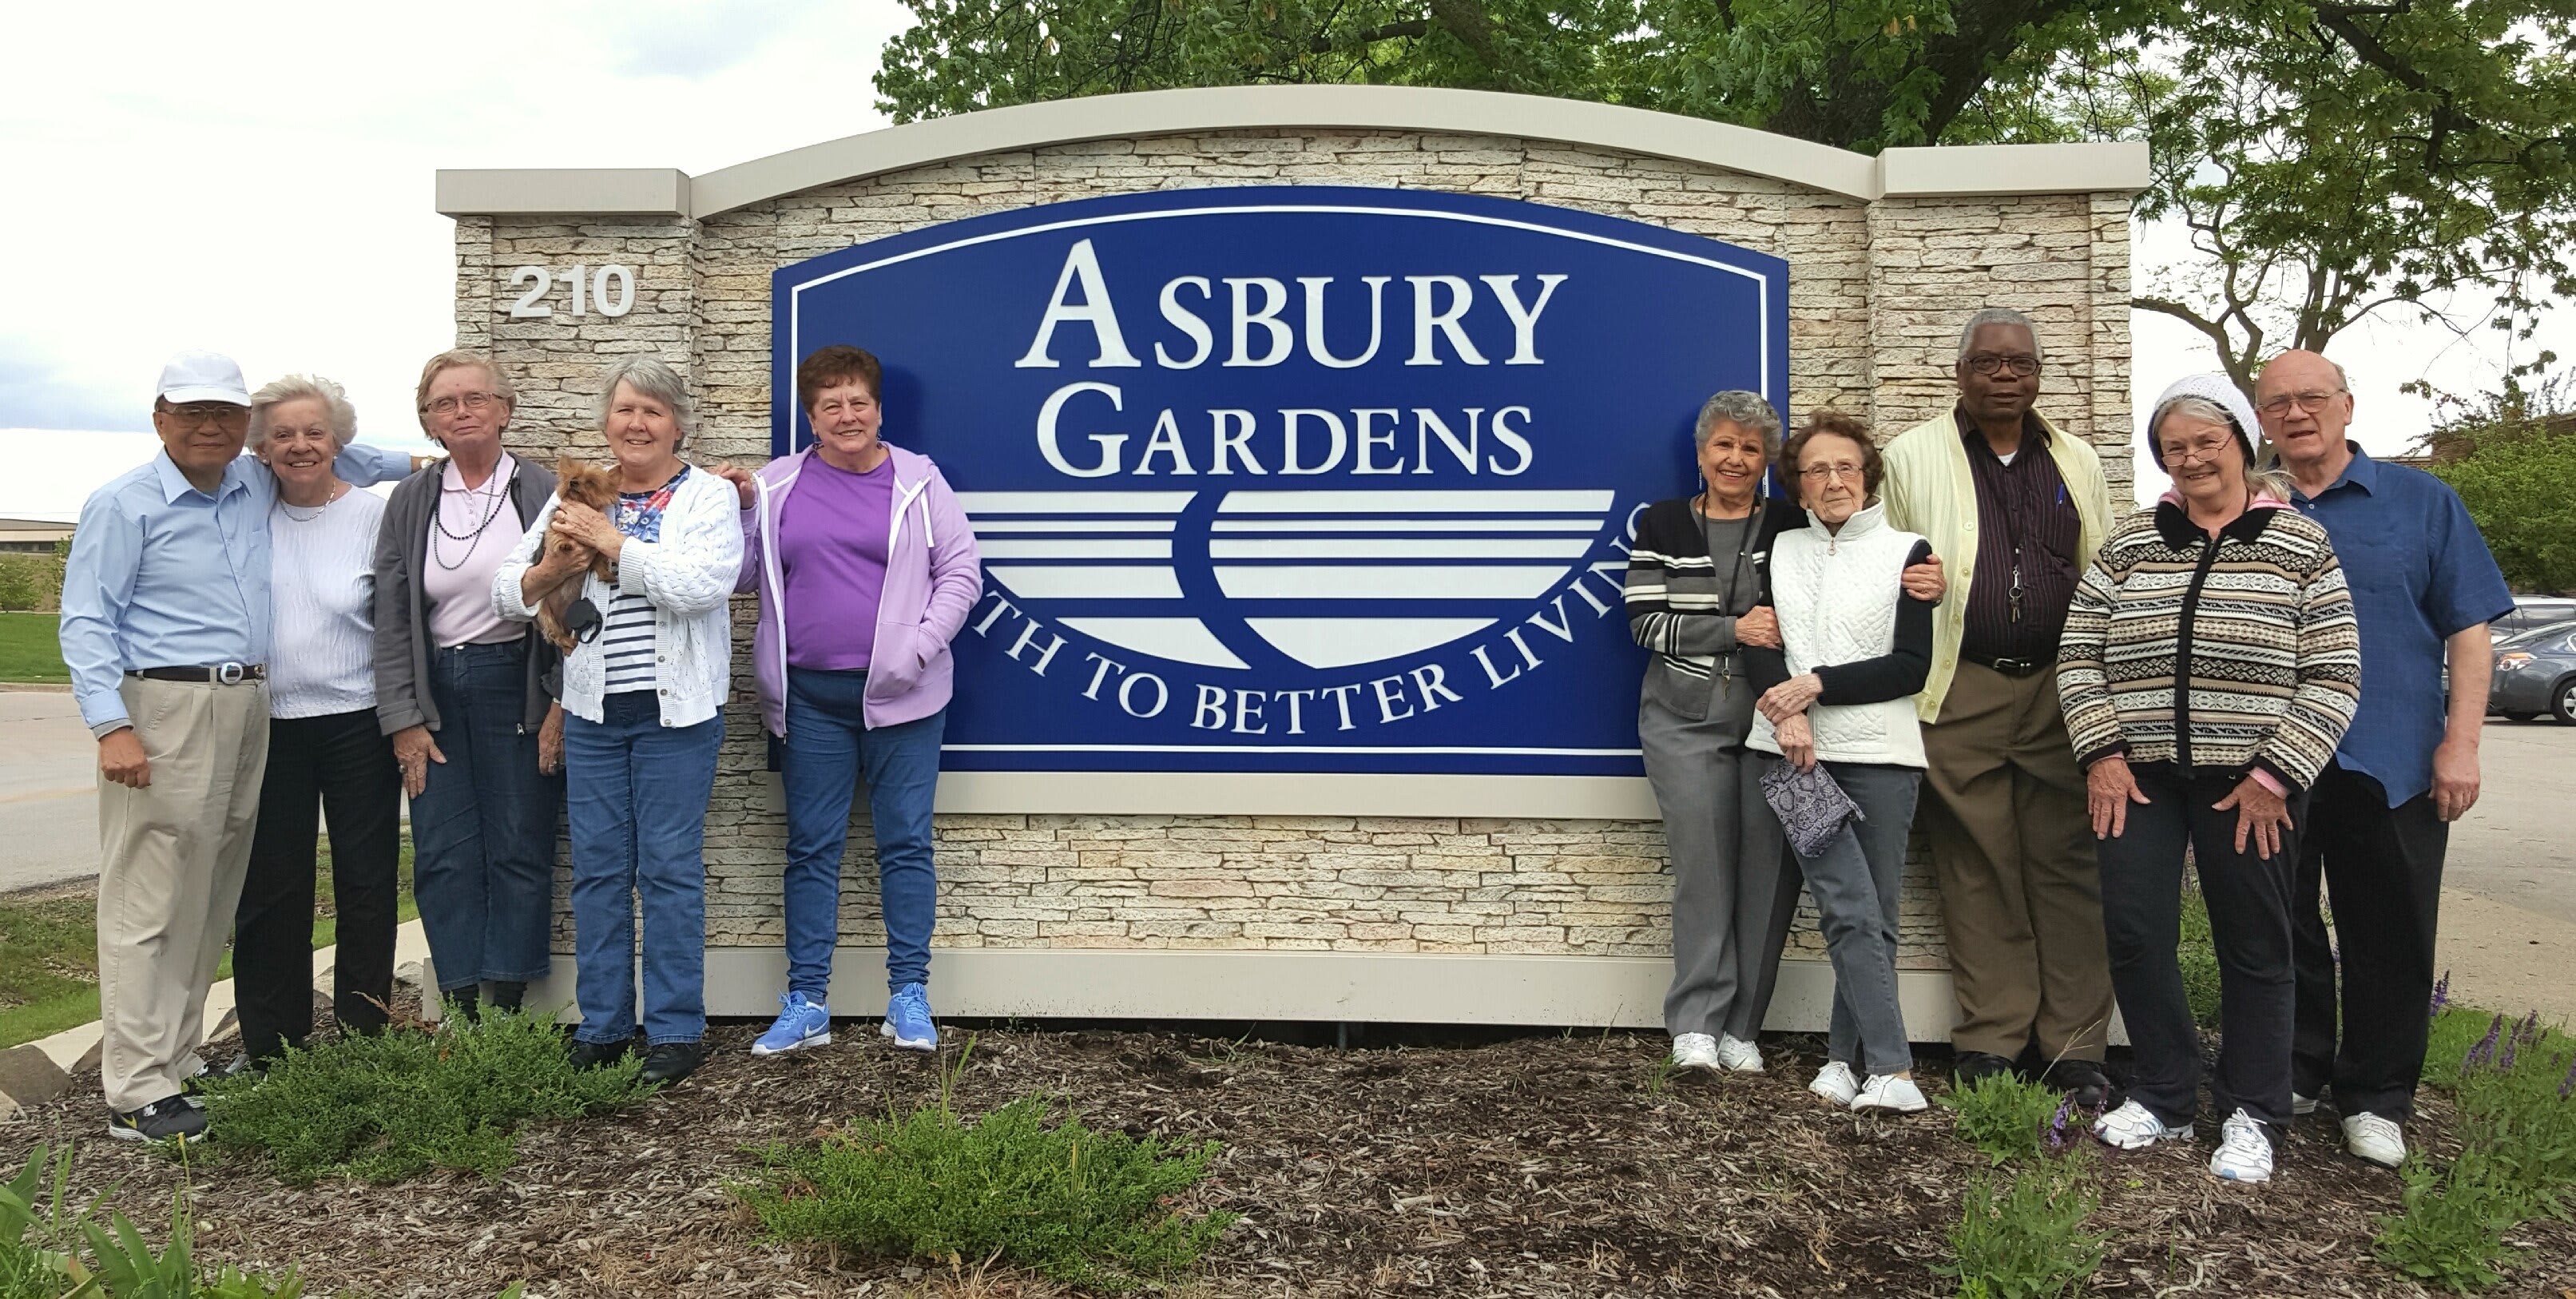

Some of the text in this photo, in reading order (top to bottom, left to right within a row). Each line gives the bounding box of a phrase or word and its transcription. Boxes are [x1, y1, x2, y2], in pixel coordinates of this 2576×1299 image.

[510, 264, 636, 319] 210
[1014, 238, 1570, 370] ASBURY
[1037, 381, 1534, 478] GARDENS
[971, 578, 1069, 677] TH
[1082, 652, 1169, 718] TO
[1189, 664, 1463, 735] BETTER
